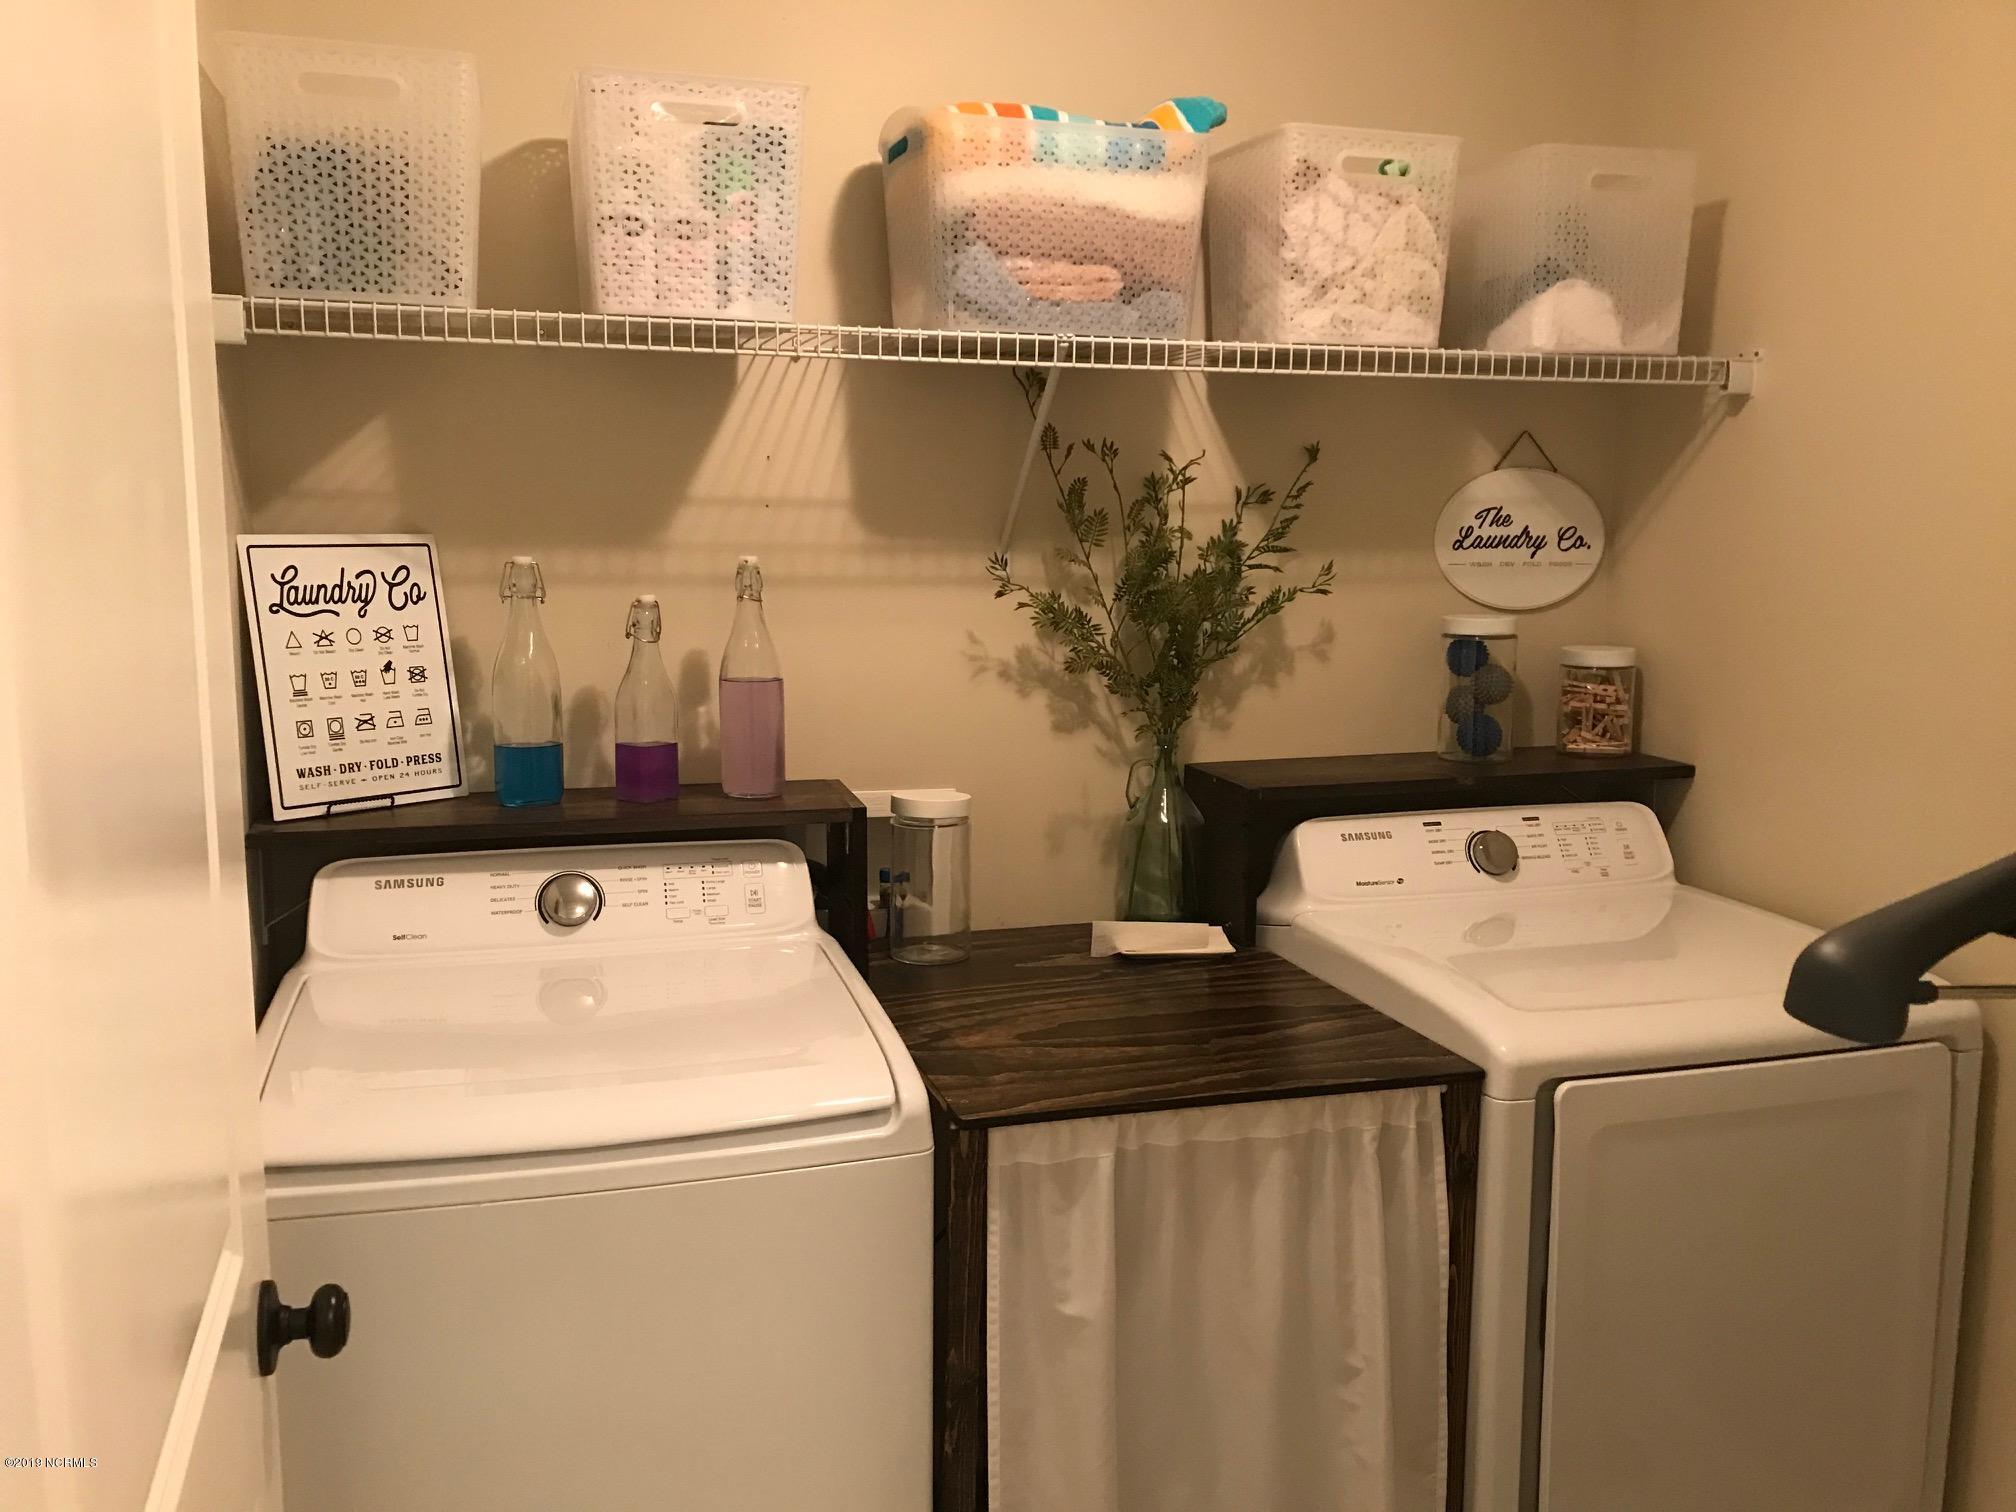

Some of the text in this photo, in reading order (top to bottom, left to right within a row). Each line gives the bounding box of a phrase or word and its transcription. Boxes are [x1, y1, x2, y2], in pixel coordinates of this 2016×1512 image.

[1474, 505, 1514, 529] The
[1452, 525, 1592, 559] Laundry Co.
[268, 564, 427, 619] Laundry Co
[296, 752, 443, 779] WASH DRY FOLD PRESS
[371, 773, 396, 782] OPEN
[399, 771, 410, 779] 24
[414, 767, 443, 777] HOURS
[1340, 830, 1393, 842] SAMSUNG
[374, 876, 445, 890] SAMSUNG
